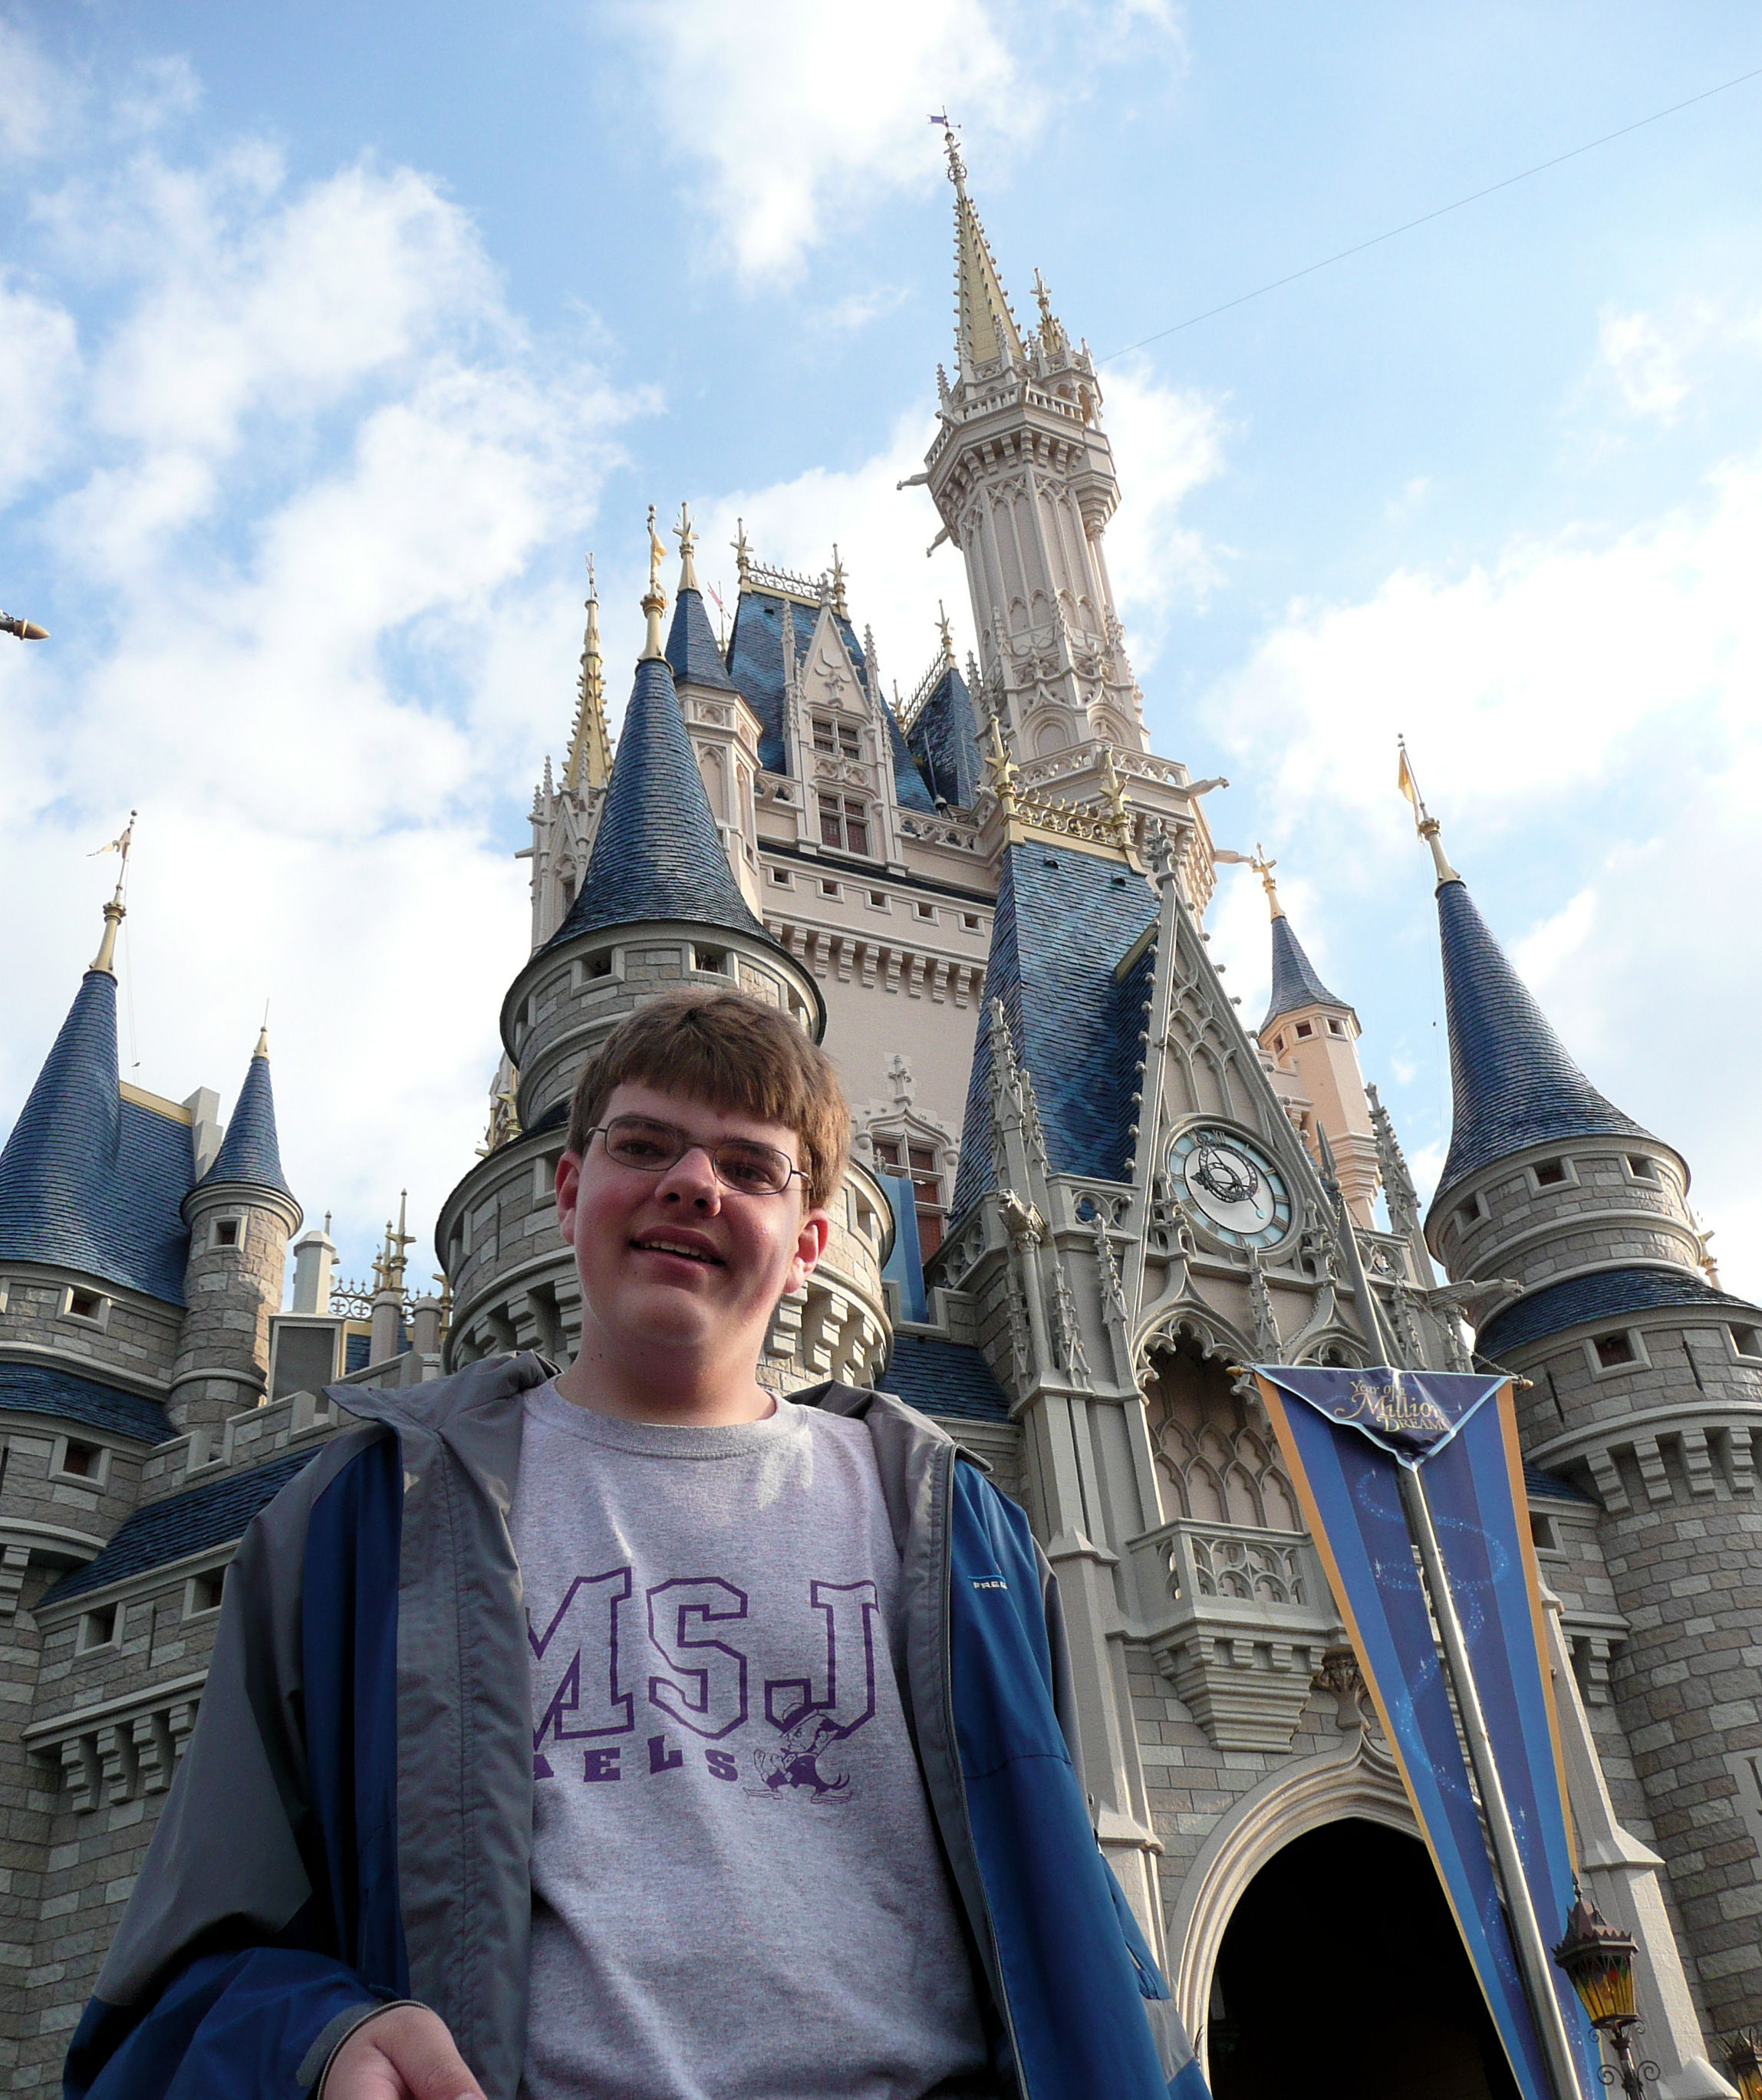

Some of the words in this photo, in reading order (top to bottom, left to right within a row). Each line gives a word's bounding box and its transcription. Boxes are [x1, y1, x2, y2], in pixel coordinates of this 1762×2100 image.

[1350, 1380, 1380, 1395] Year
[1383, 1382, 1395, 1402] of
[1376, 1416, 1448, 1432] DREAM
